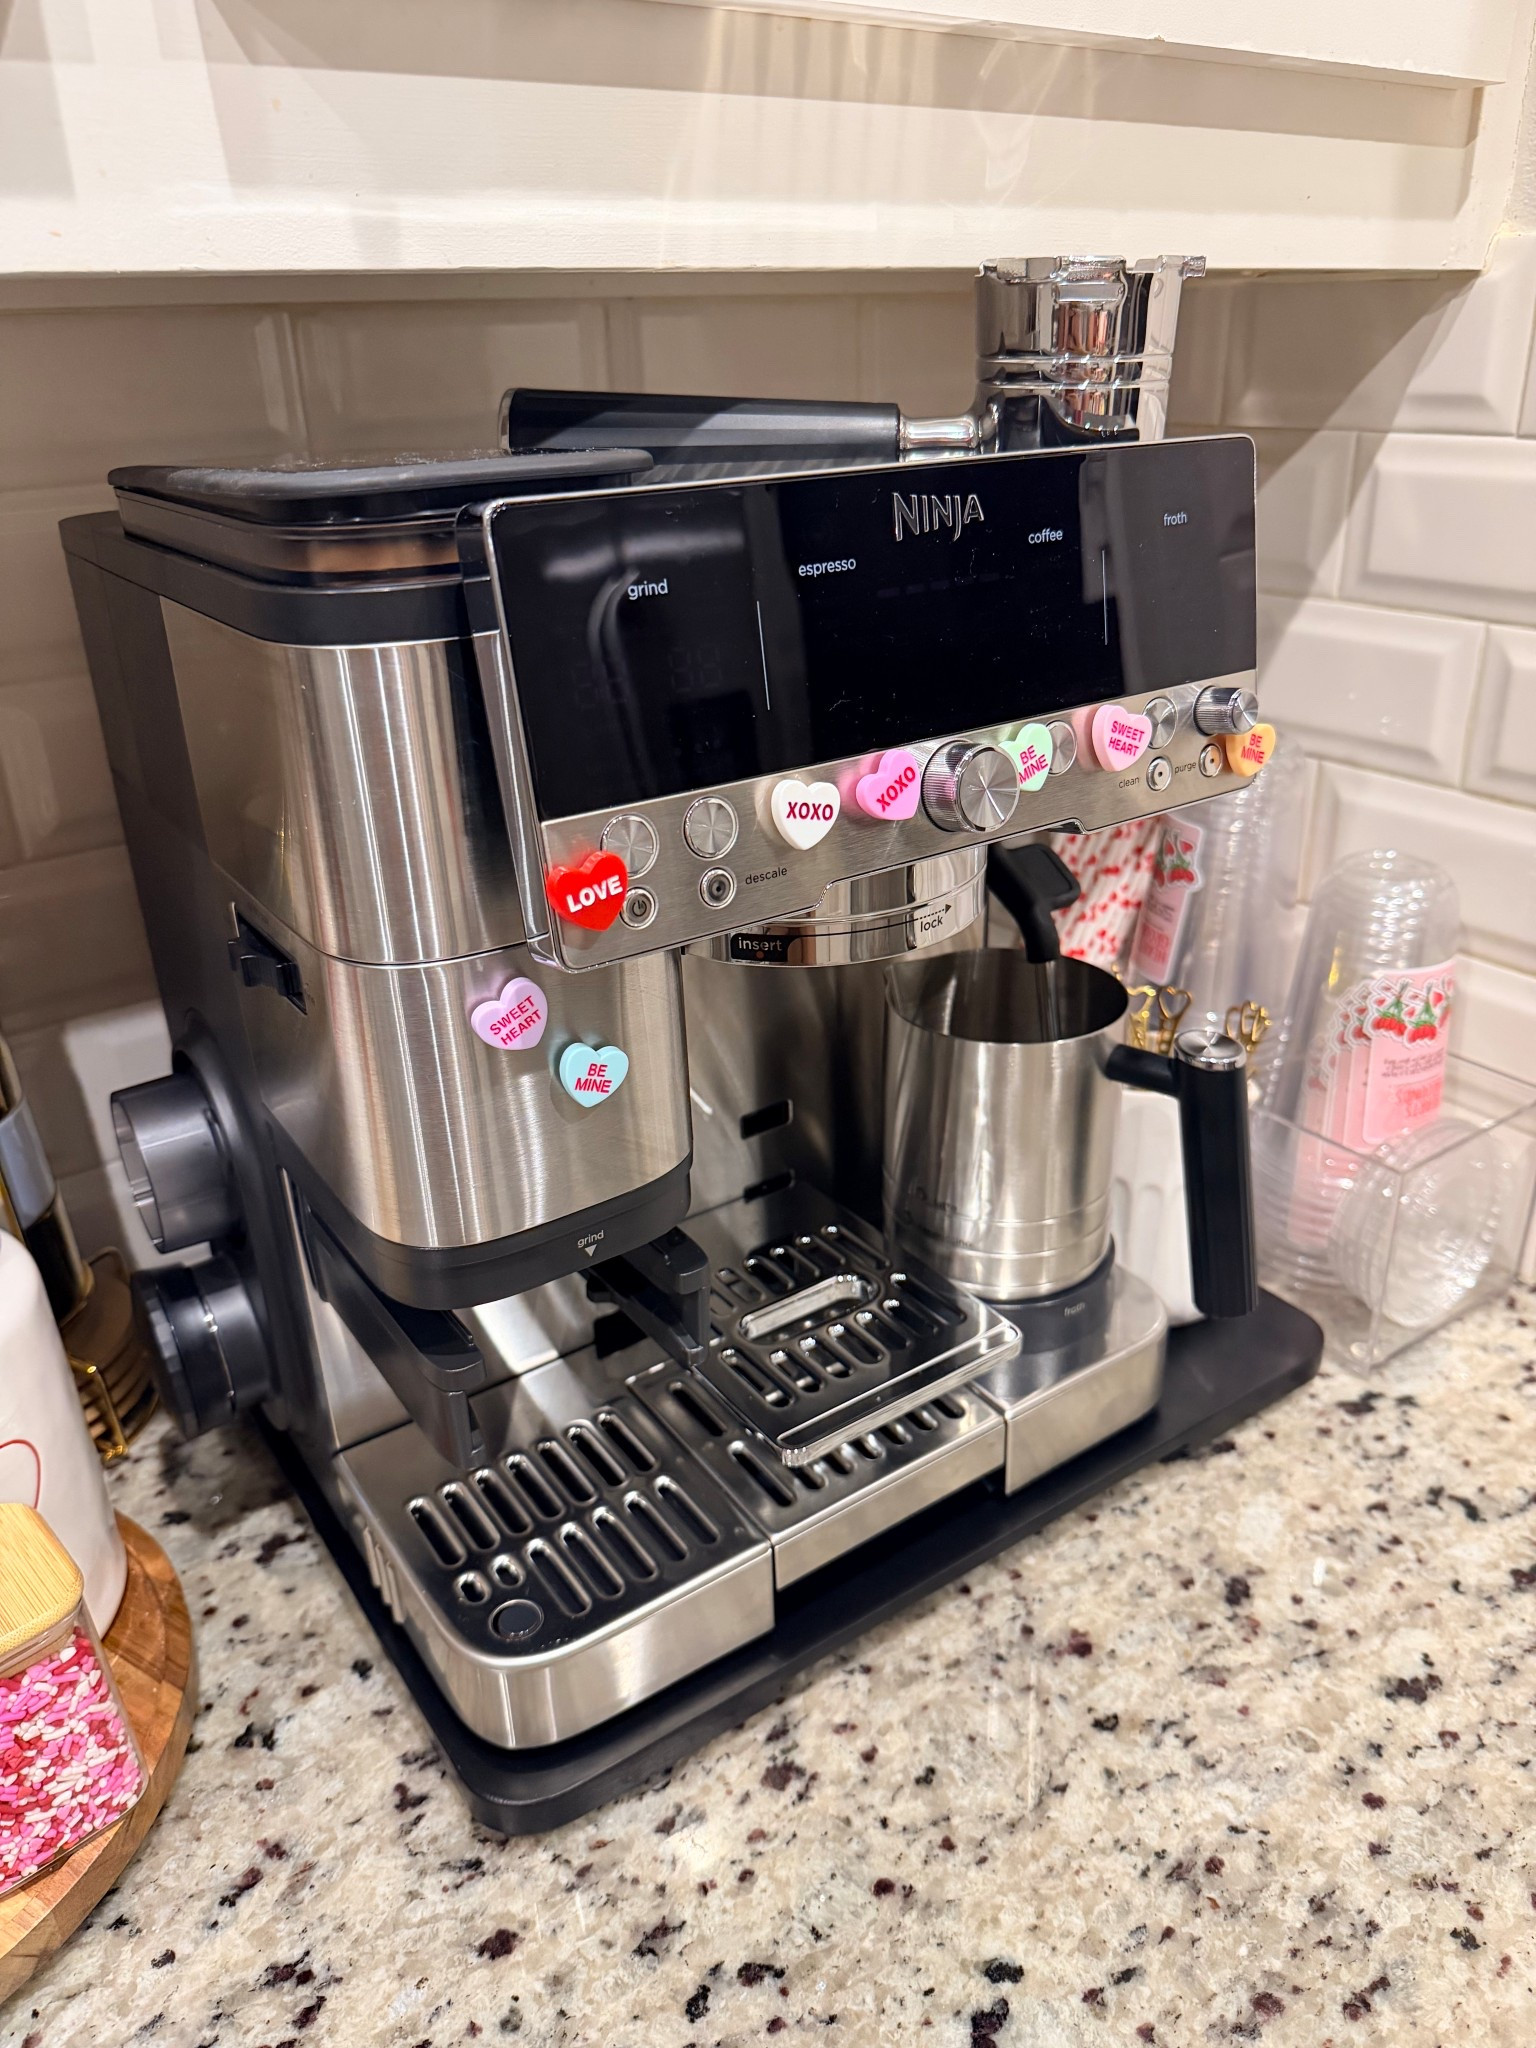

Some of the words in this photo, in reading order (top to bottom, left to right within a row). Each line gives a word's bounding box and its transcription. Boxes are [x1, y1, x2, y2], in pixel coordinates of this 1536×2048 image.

[892, 492, 984, 541] NINJA
[1163, 511, 1187, 527] froth
[1027, 528, 1064, 544] coffee
[798, 556, 857, 578] espresso
[627, 578, 669, 601] grind
[1111, 720, 1145, 744] SWEET
[1249, 733, 1263, 748] BE
[1019, 745, 1037, 767] BE
[1108, 736, 1140, 758] HEART
[1241, 747, 1265, 764] MINE
[1019, 754, 1049, 785] MINE
[1174, 761, 1197, 775] purge
[876, 766, 916, 812] XOXO
[1118, 776, 1140, 789] clean
[786, 801, 834, 822] XOXO
[745, 866, 788, 885] descale
[566, 875, 624, 913] LOVE
[919, 915, 944, 933] lock
[738, 937, 783, 951] insert
[489, 995, 535, 1035] SWEET
[501, 1009, 542, 1046] HEART
[587, 1063, 608, 1078] BE
[574, 1077, 612, 1094] MINE
[577, 1229, 605, 1249] grind
